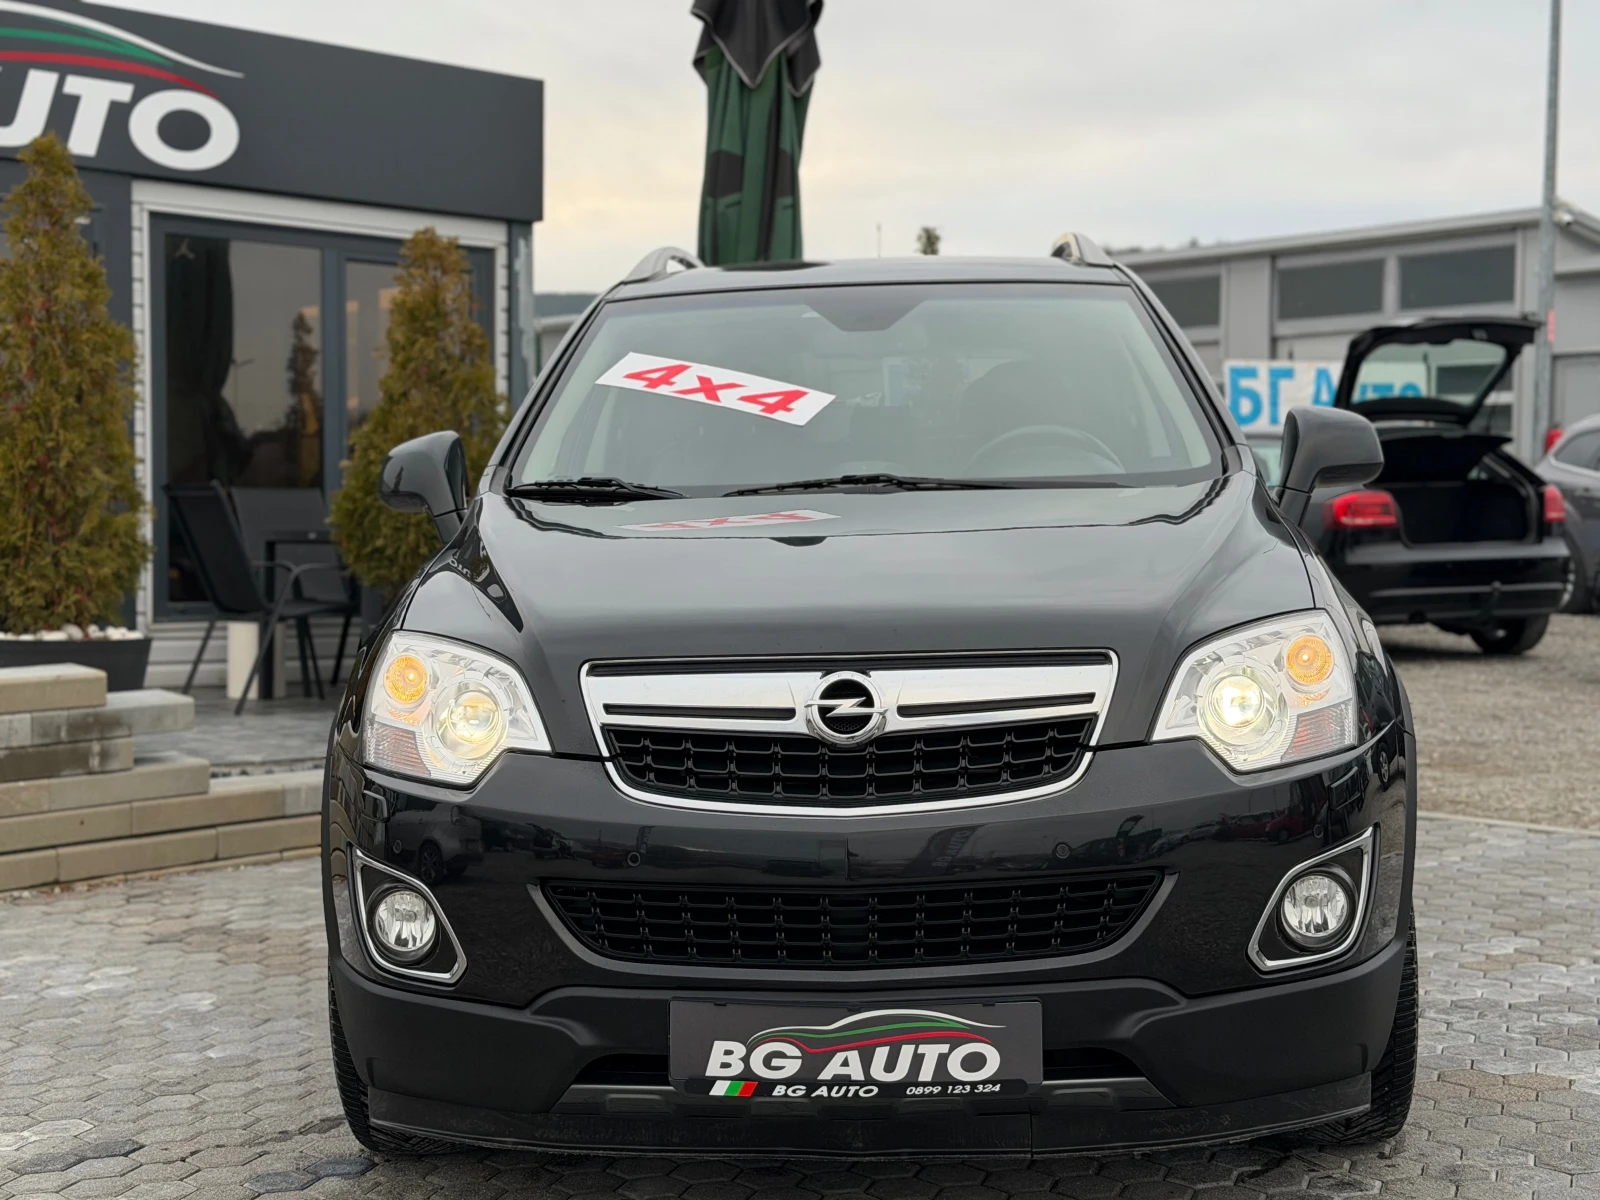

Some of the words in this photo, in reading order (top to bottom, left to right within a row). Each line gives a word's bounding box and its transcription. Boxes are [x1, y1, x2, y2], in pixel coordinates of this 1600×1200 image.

[1229, 366, 1295, 427] БГ
[704, 1040, 803, 1079] BG
[817, 1042, 1001, 1082] AUTO
[771, 1084, 807, 1097] BG
[810, 1085, 879, 1098] AUTO
[905, 1086, 942, 1096] 0899
[946, 1084, 971, 1094] 123
[974, 1083, 1001, 1093] 324
